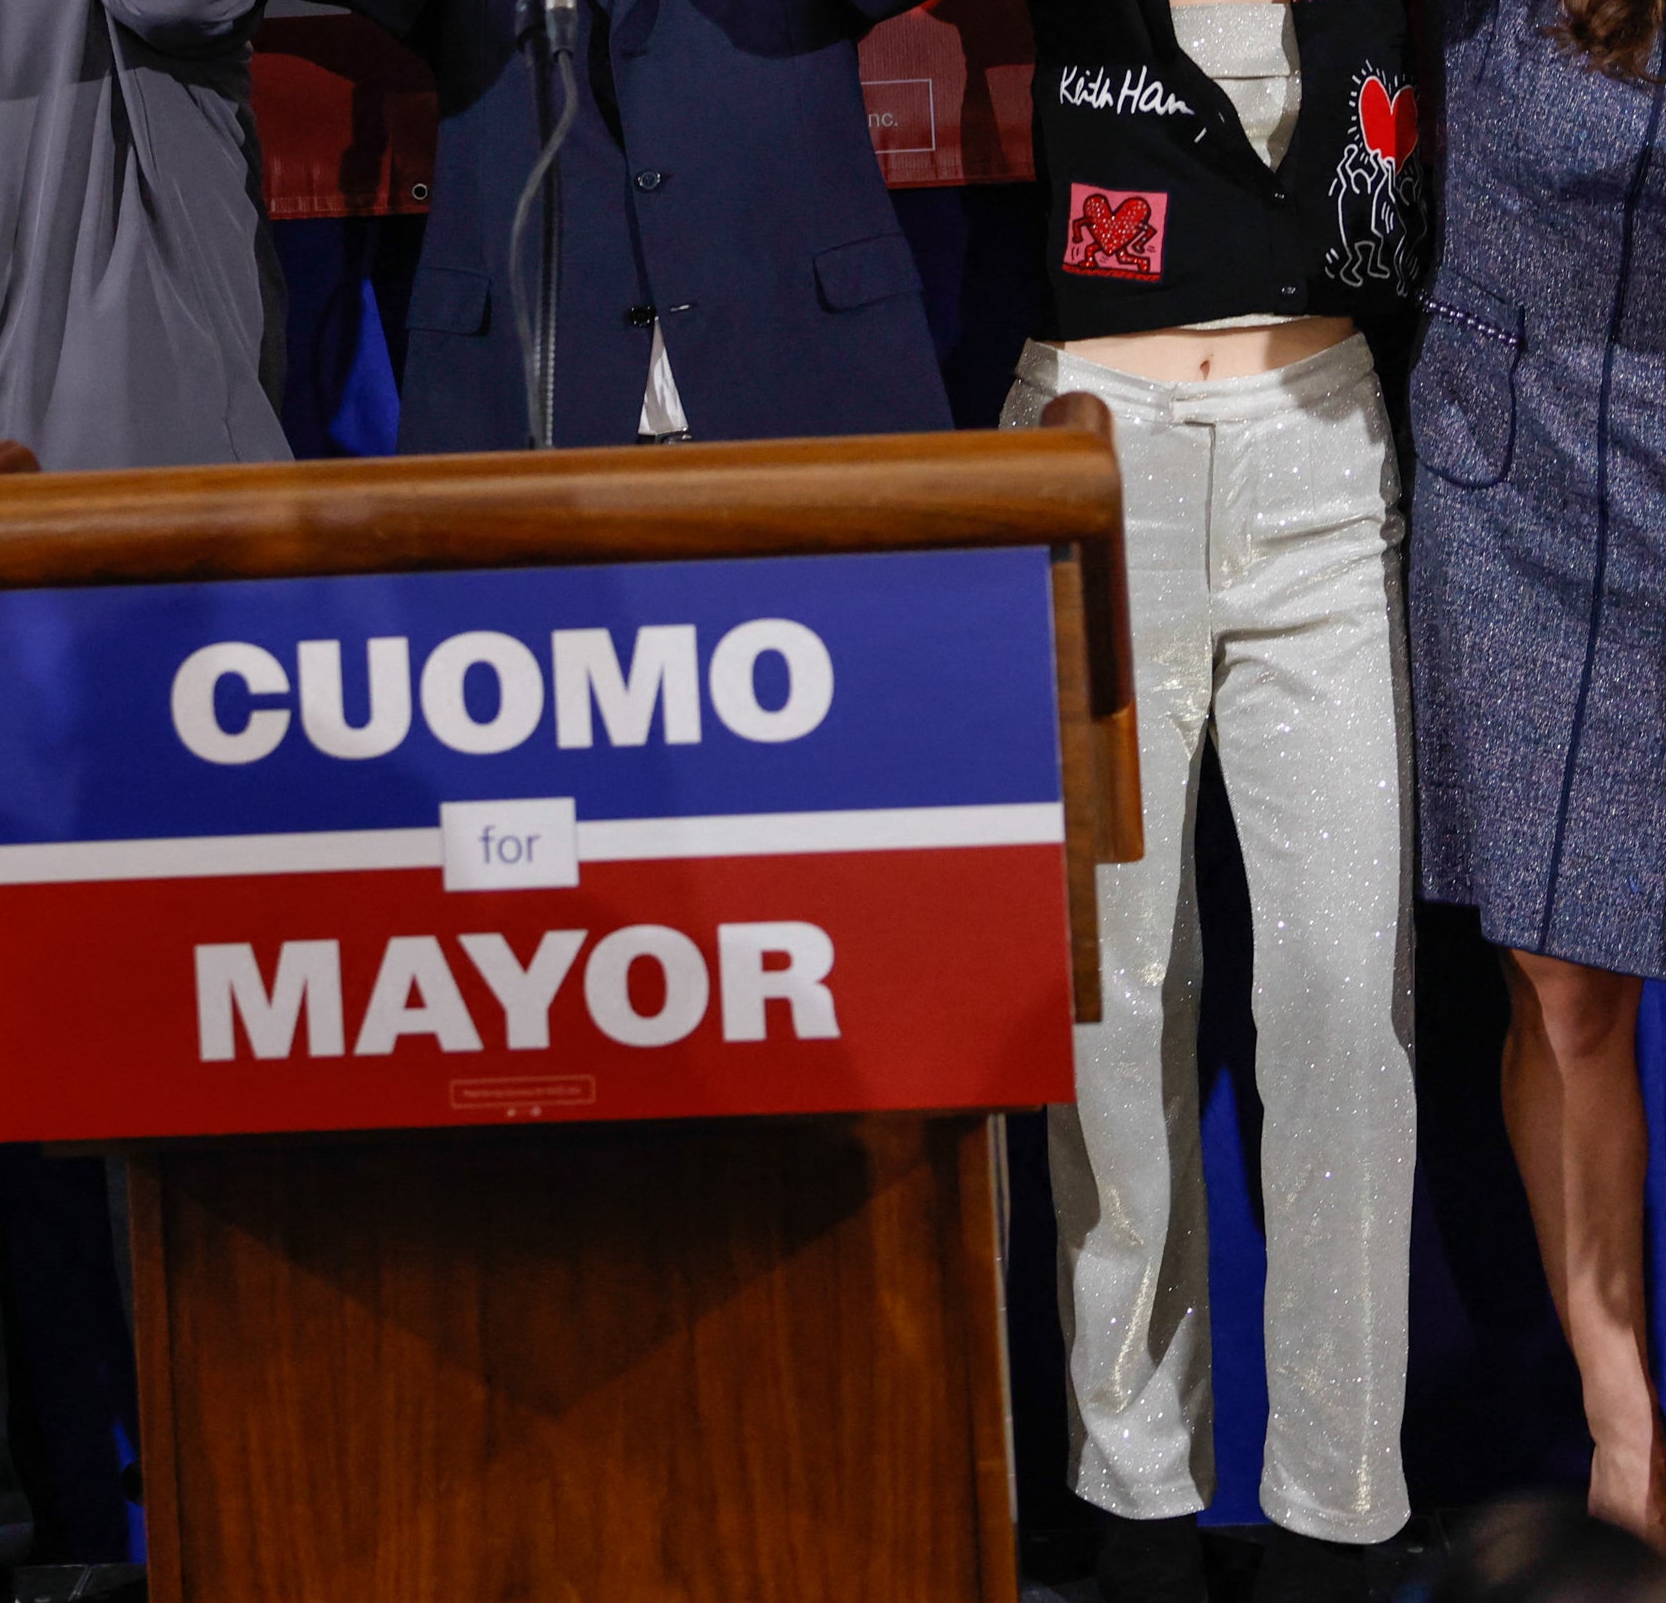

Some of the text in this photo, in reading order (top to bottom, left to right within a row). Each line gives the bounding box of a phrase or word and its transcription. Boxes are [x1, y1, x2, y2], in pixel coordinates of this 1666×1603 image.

[1059, 65, 1114, 110] Keith
[170, 618, 834, 765] CUOMO
[478, 824, 542, 865] for
[193, 919, 841, 1063] MAYOR
